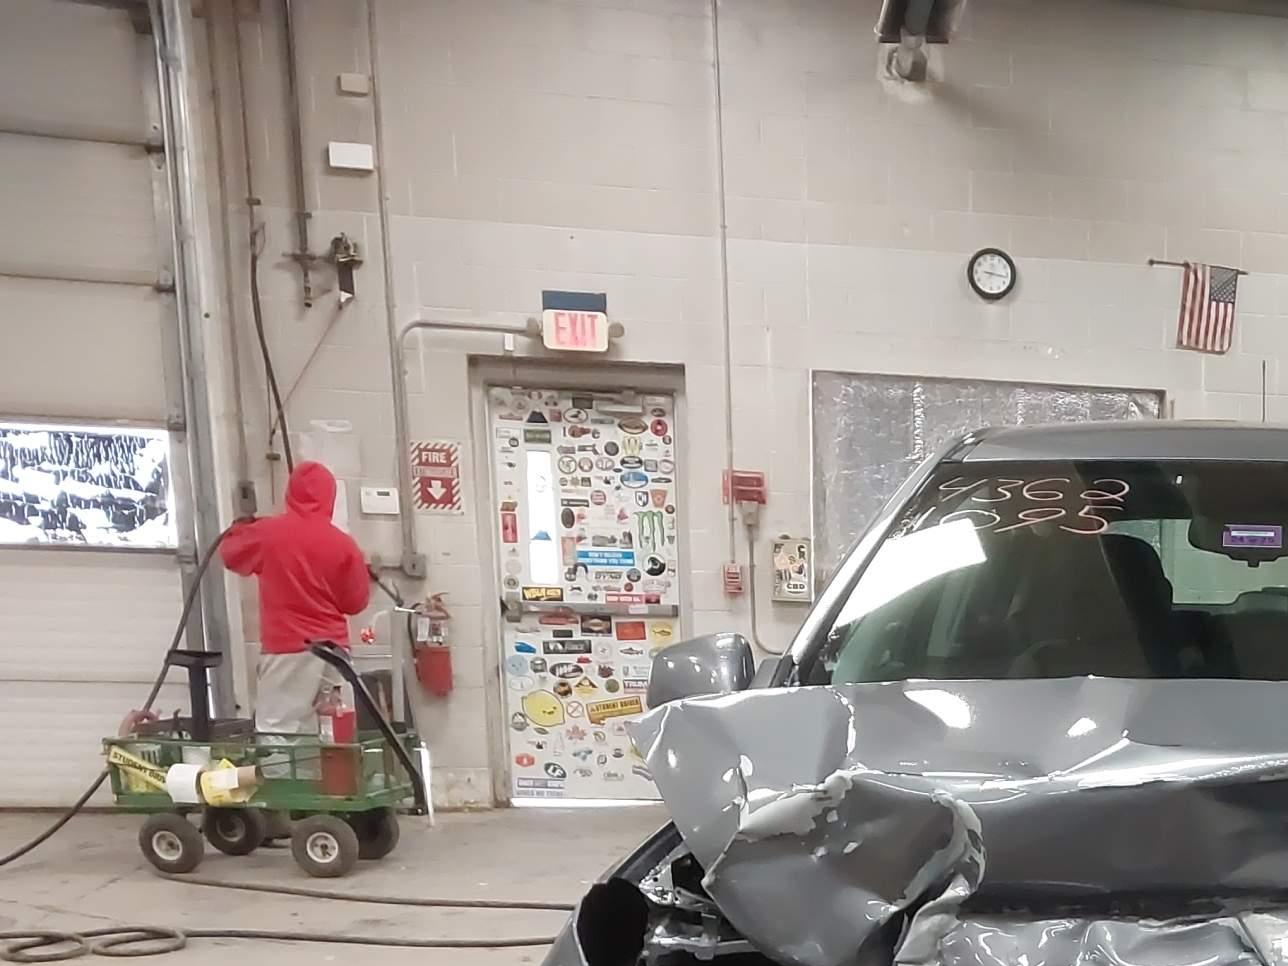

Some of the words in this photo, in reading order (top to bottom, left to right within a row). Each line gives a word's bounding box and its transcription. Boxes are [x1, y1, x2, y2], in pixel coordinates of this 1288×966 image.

[554, 312, 598, 346] EXIT
[421, 451, 447, 463] FIRE
[112, 752, 148, 773] STUDENT
